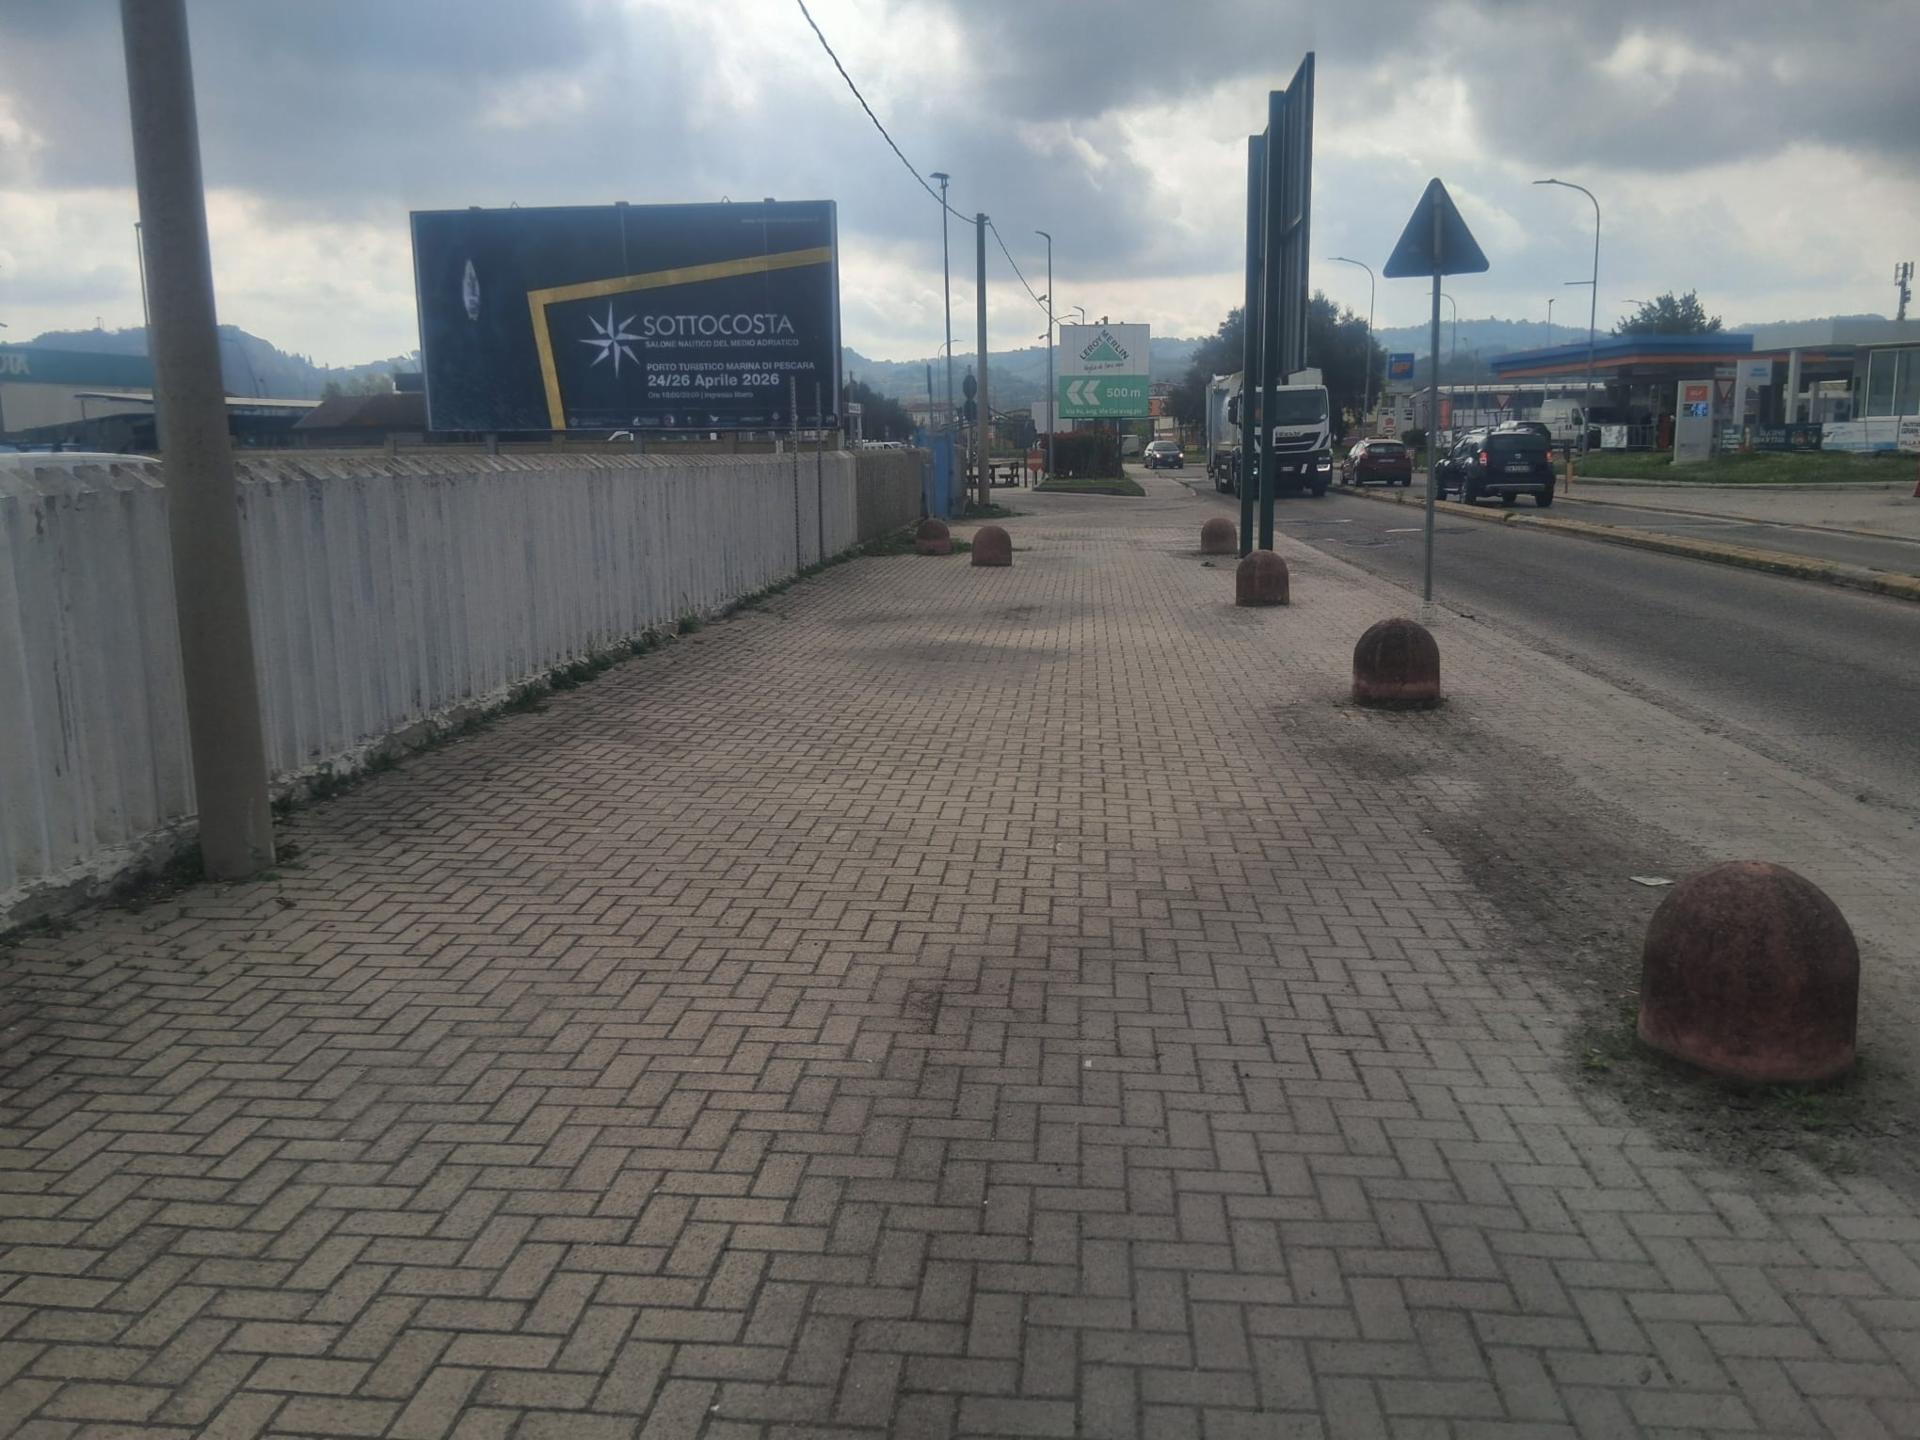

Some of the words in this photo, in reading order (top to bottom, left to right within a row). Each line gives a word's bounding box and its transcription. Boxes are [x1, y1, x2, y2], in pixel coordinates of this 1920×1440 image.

[643, 314, 795, 336] SOTTOCOSTA
[646, 340, 677, 348] SALONE
[678, 339, 712, 348] NAUTICO
[713, 339, 730, 347] DEL
[731, 339, 756, 347] MEDIO
[757, 338, 799, 347] ADRIATICO
[1080, 336, 1103, 360] LEROY
[1101, 329, 1129, 360] MERLIN
[647, 363, 677, 371] PORTO
[678, 362, 725, 371] TURISTICO
[726, 362, 761, 370] MARINA
[762, 362, 772, 370] DI
[774, 361, 815, 370] PESCARA
[648, 374, 691, 387] 24/26
[695, 373, 738, 389] Aprile
[742, 373, 780, 386] 2026
[1106, 387, 1128, 398] 500
[1130, 389, 1141, 398] m
